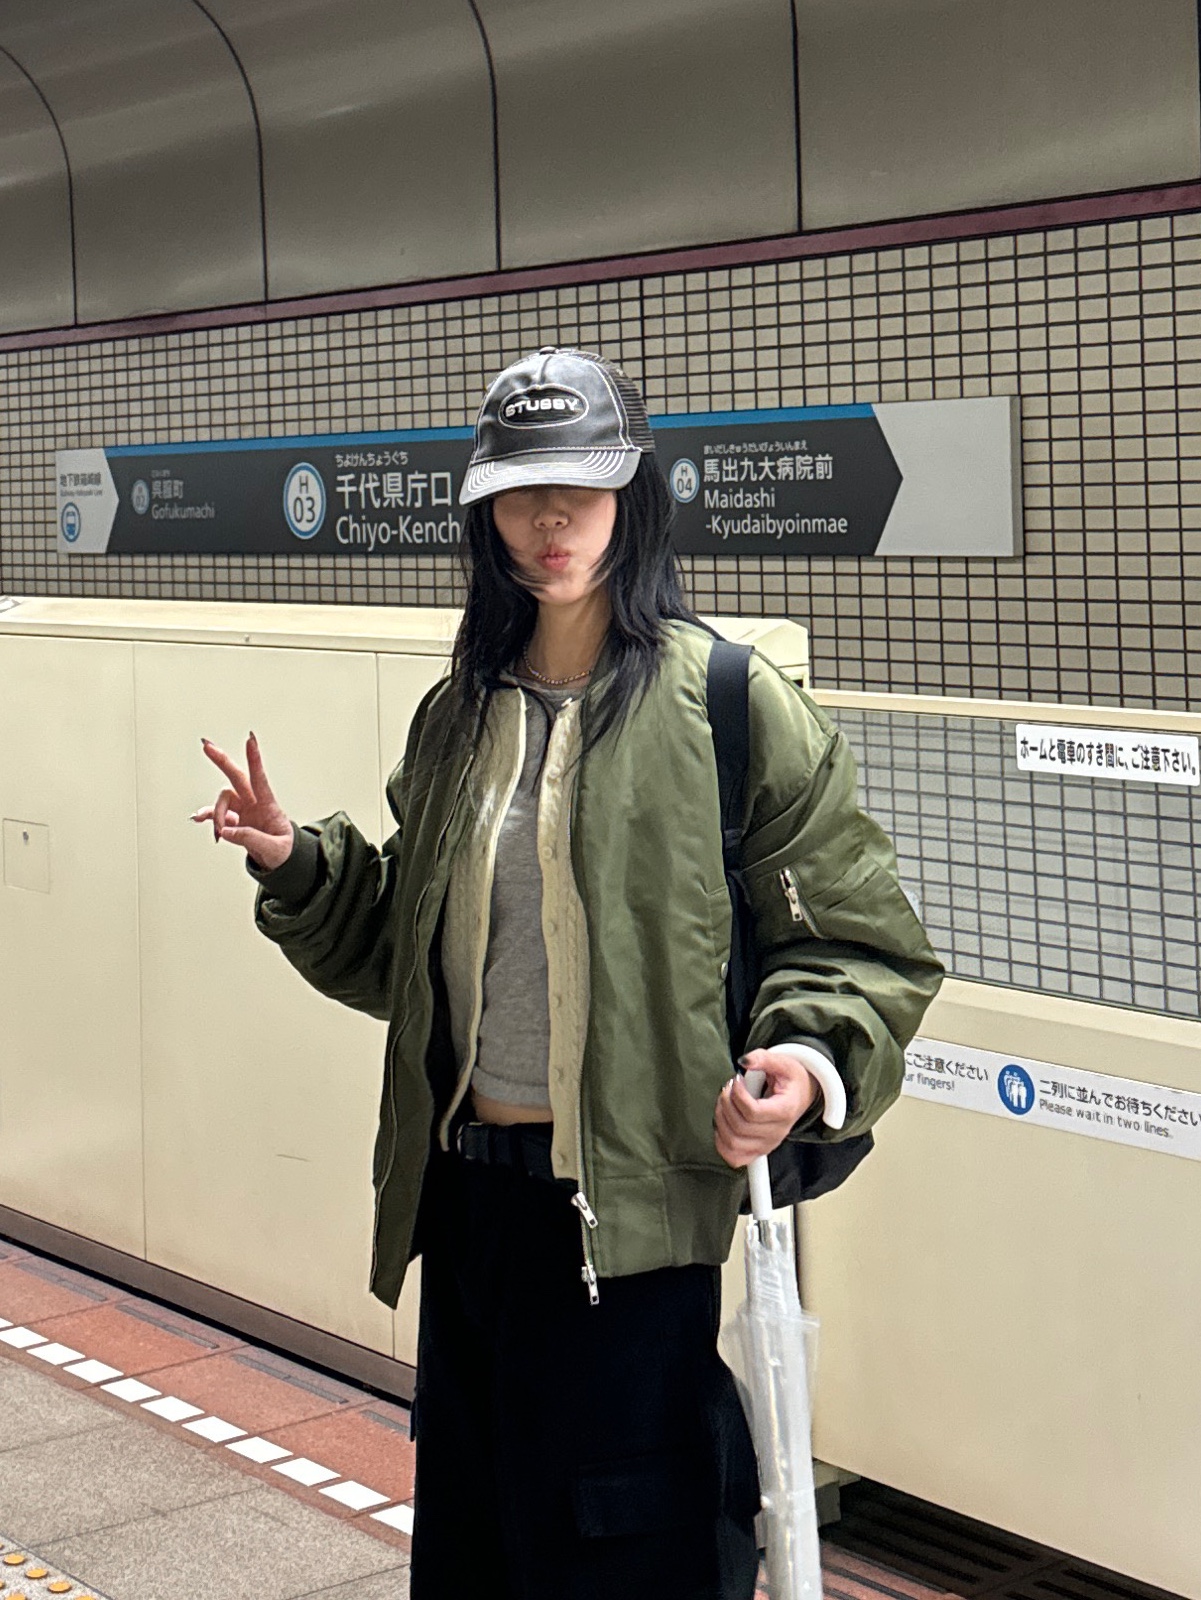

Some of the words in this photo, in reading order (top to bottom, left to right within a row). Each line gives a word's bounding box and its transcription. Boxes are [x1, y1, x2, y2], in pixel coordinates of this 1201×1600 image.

[680, 466, 688, 476] H
[703, 453, 833, 483] 馬出九大病院前
[299, 475, 309, 494] H
[335, 470, 452, 509] 千代県庁口
[676, 479, 693, 494] 04
[704, 487, 775, 509] Maidashi
[151, 502, 215, 520] Gofukumachi
[293, 496, 316, 524] 03
[335, 513, 461, 551] Chiyo-Kench
[705, 513, 848, 540] -Kyudaibyoinmae
[1039, 1098, 1073, 1117] Please
[1076, 1107, 1100, 1122] wait
[1103, 1112, 1113, 1125] in
[1118, 1116, 1140, 1131] two
